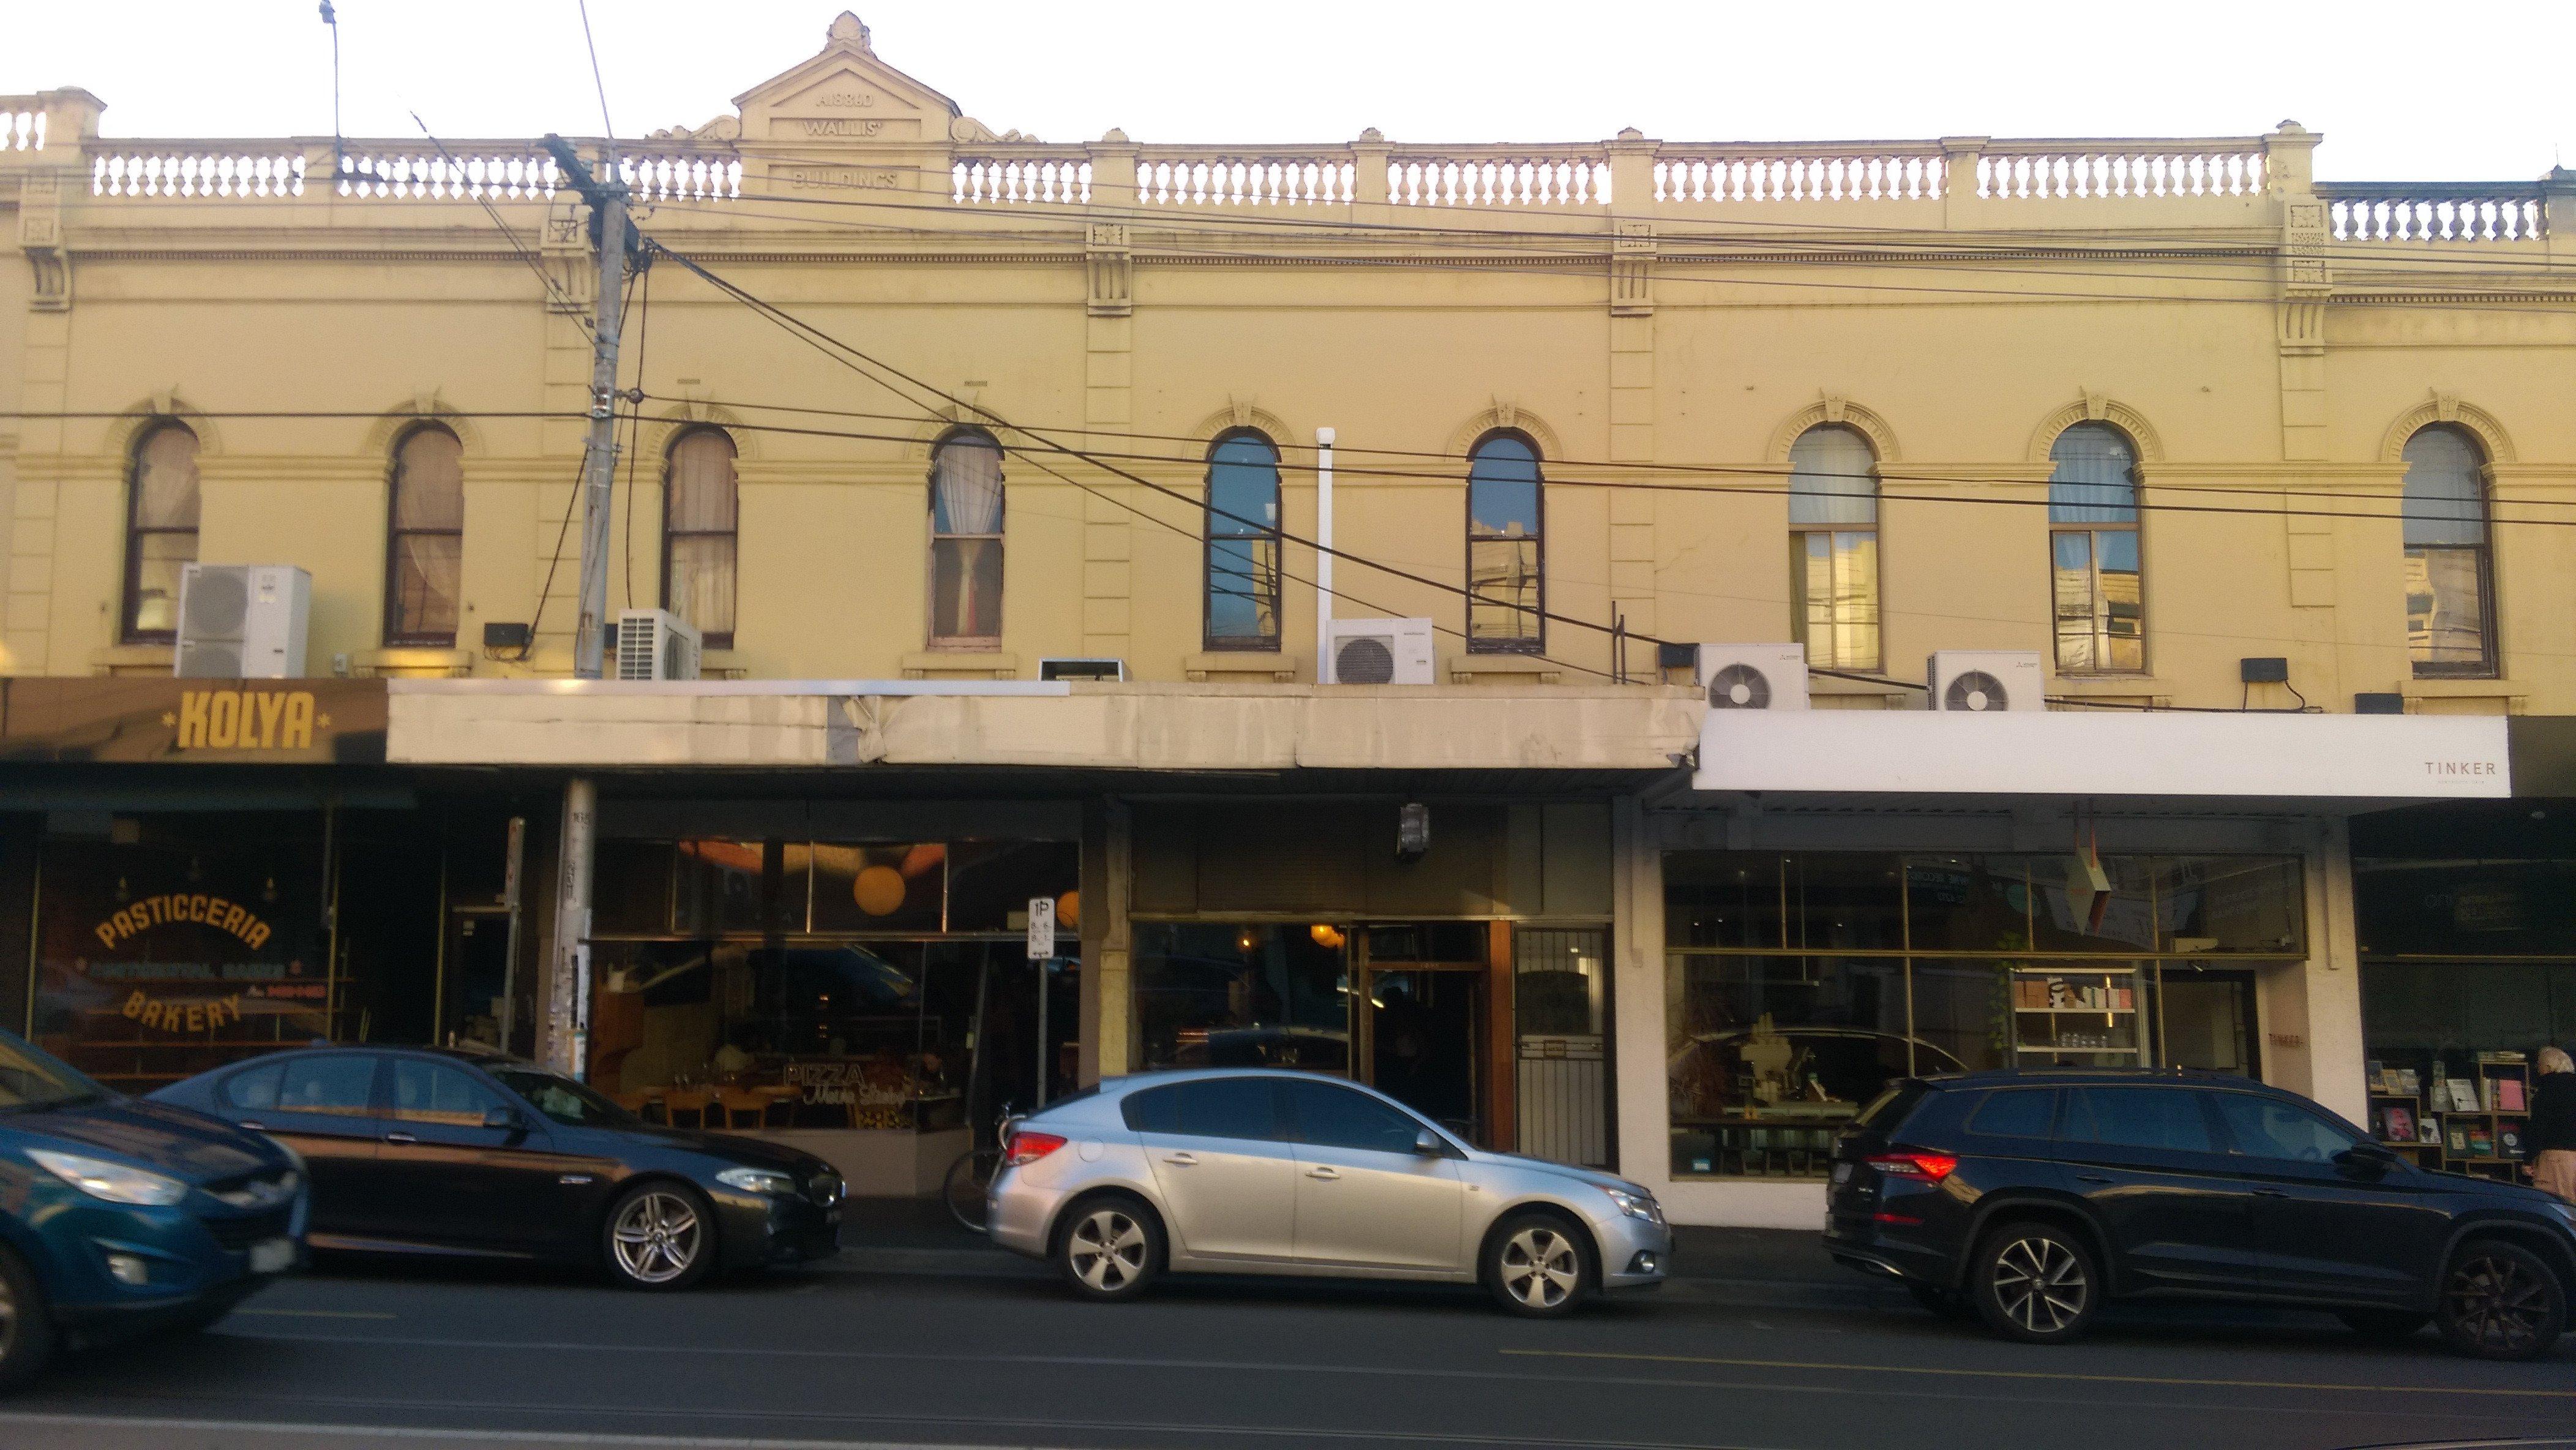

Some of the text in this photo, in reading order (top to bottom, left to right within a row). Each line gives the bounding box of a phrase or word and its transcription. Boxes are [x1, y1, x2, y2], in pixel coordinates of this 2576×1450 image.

[178, 690, 315, 749] KOLYA
[2425, 761, 2496, 775] TINKER
[95, 893, 272, 950] PASTICCERIA
[123, 990, 242, 1033] BAKERY
[784, 1063, 865, 1087] PIZZA
